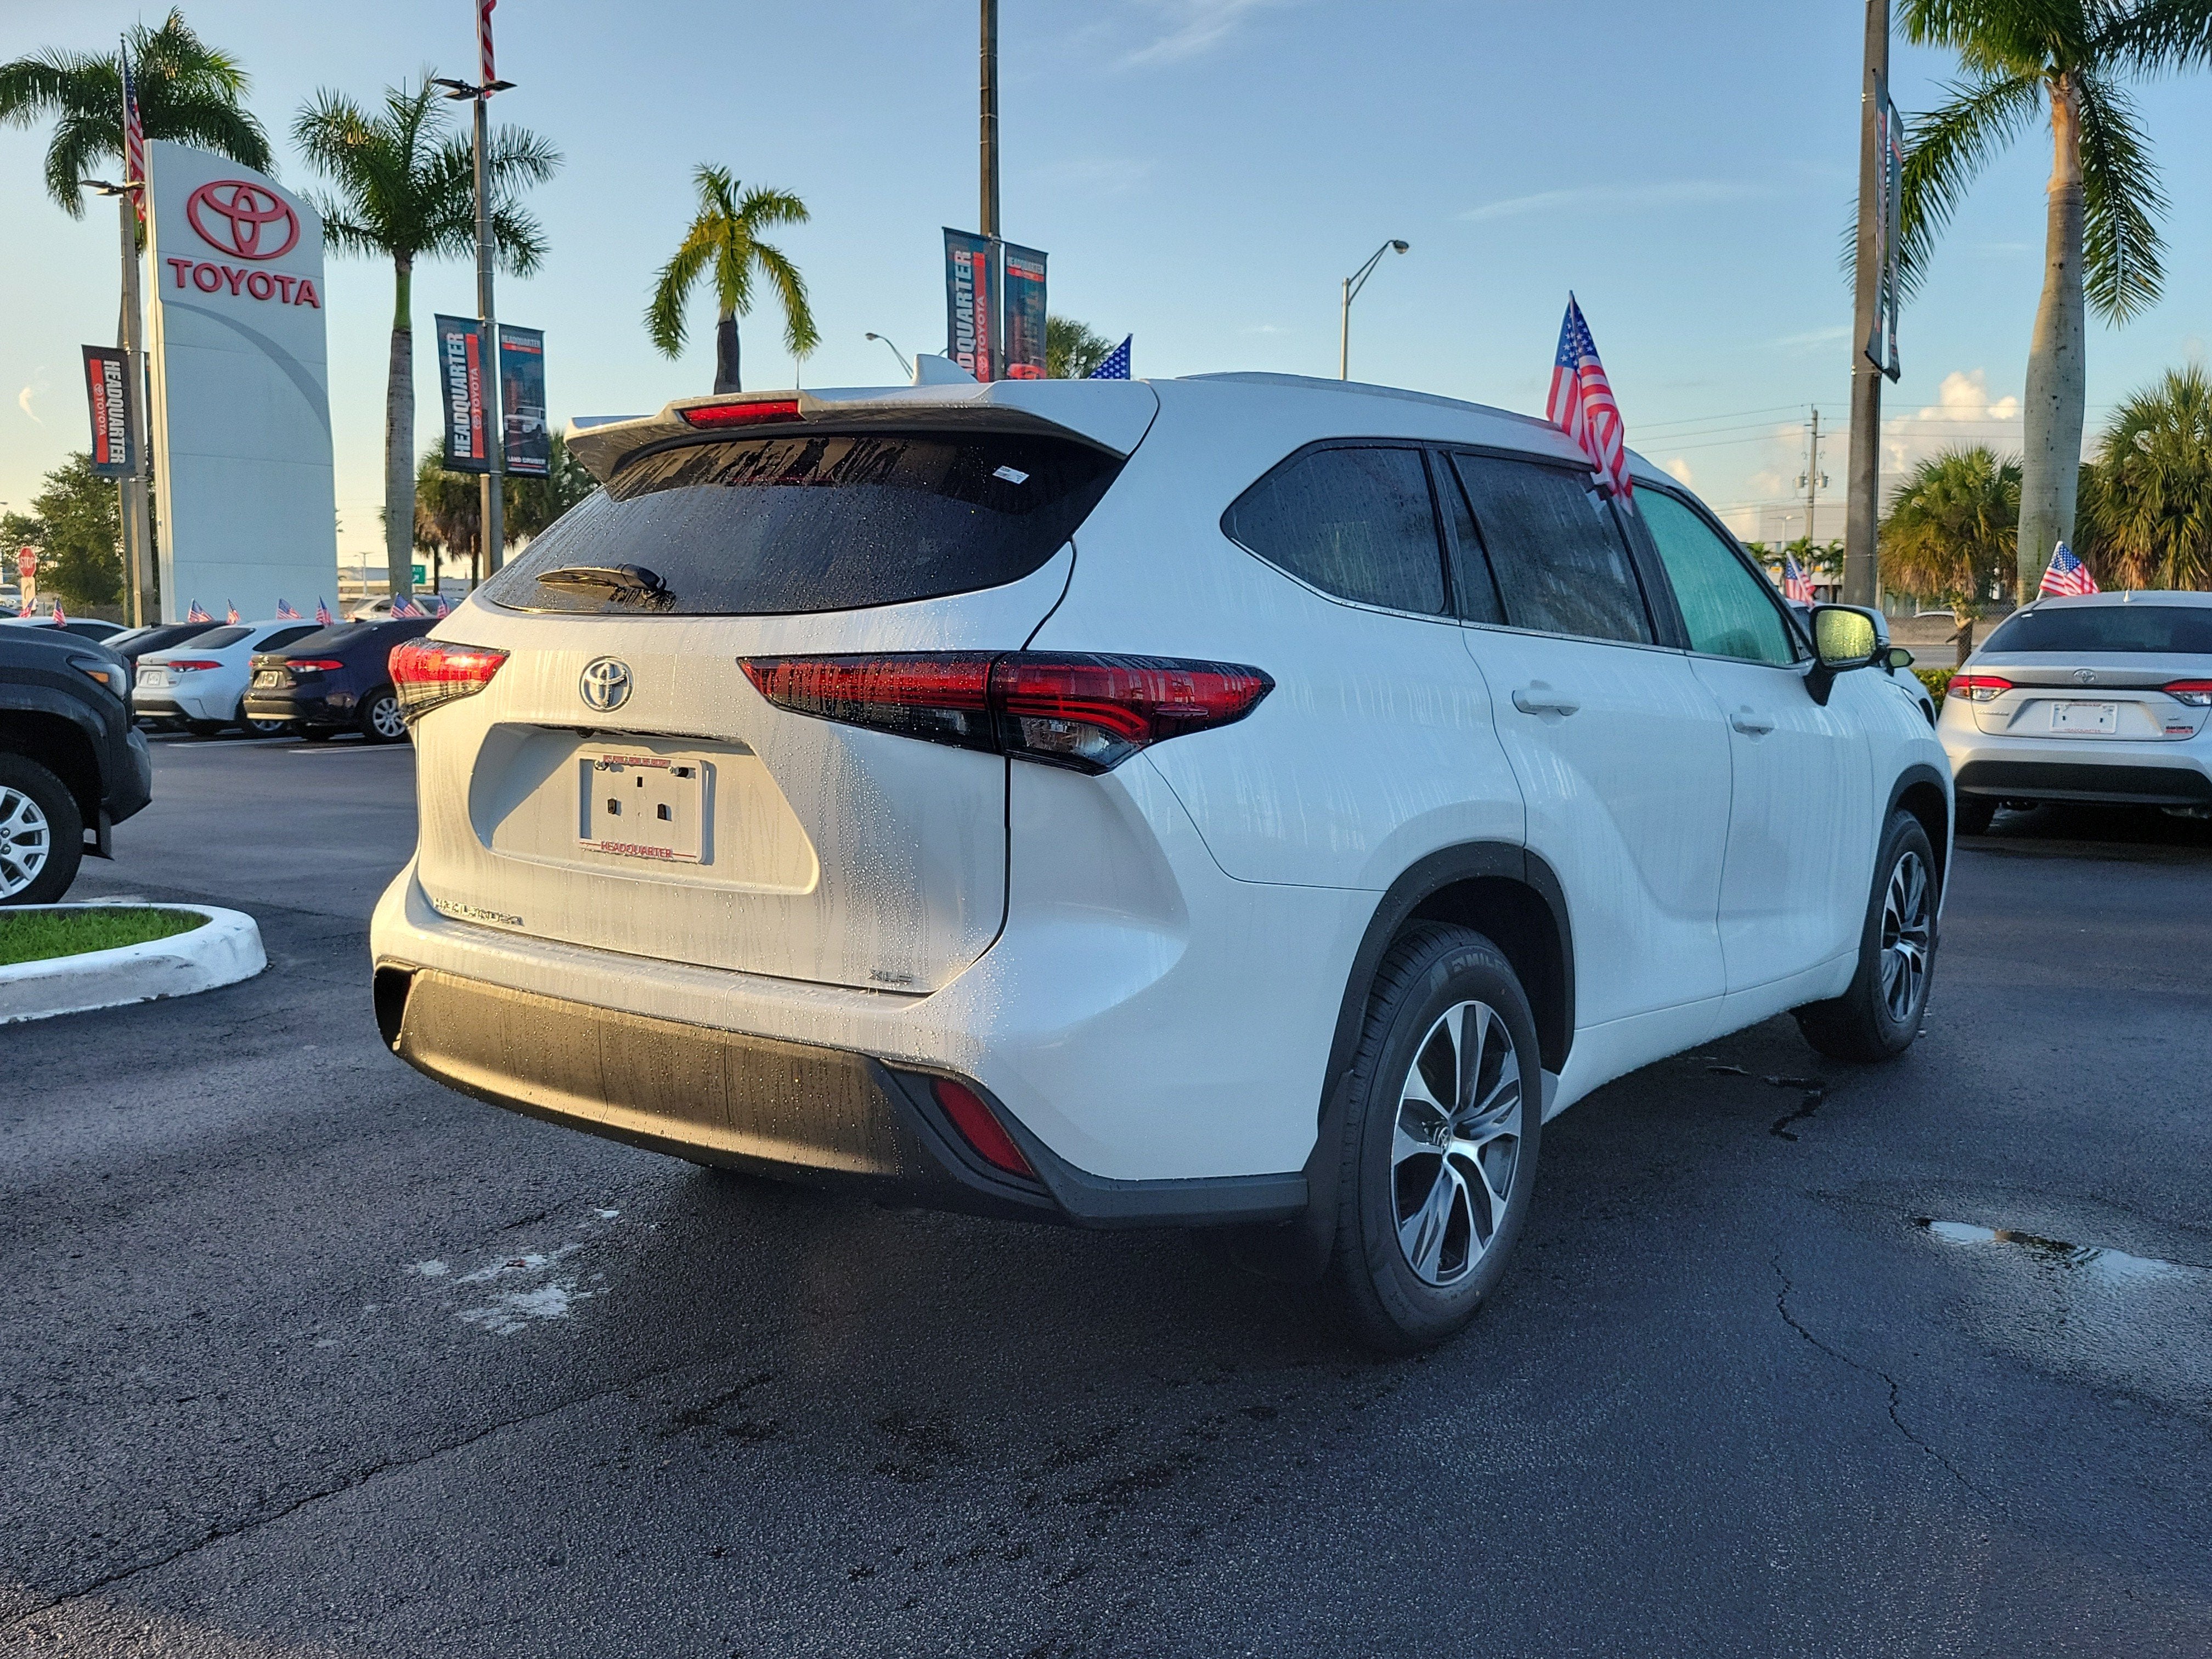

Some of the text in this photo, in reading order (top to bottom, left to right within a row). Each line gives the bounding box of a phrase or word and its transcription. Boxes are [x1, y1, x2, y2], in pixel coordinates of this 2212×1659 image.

[167, 258, 321, 308] TOYOTA
[955, 251, 977, 375] DQUARTER
[977, 296, 986, 355] TOYOTA
[103, 359, 126, 464] HEADQUARTER
[446, 332, 471, 458] HEADQUARTER
[470, 368, 481, 412] TOYOTA
[97, 396, 106, 436] TOYOTA
[21, 556, 35, 568] STOP
[600, 840, 673, 857] HEADQUARTER
[867, 968, 912, 984] XLE
